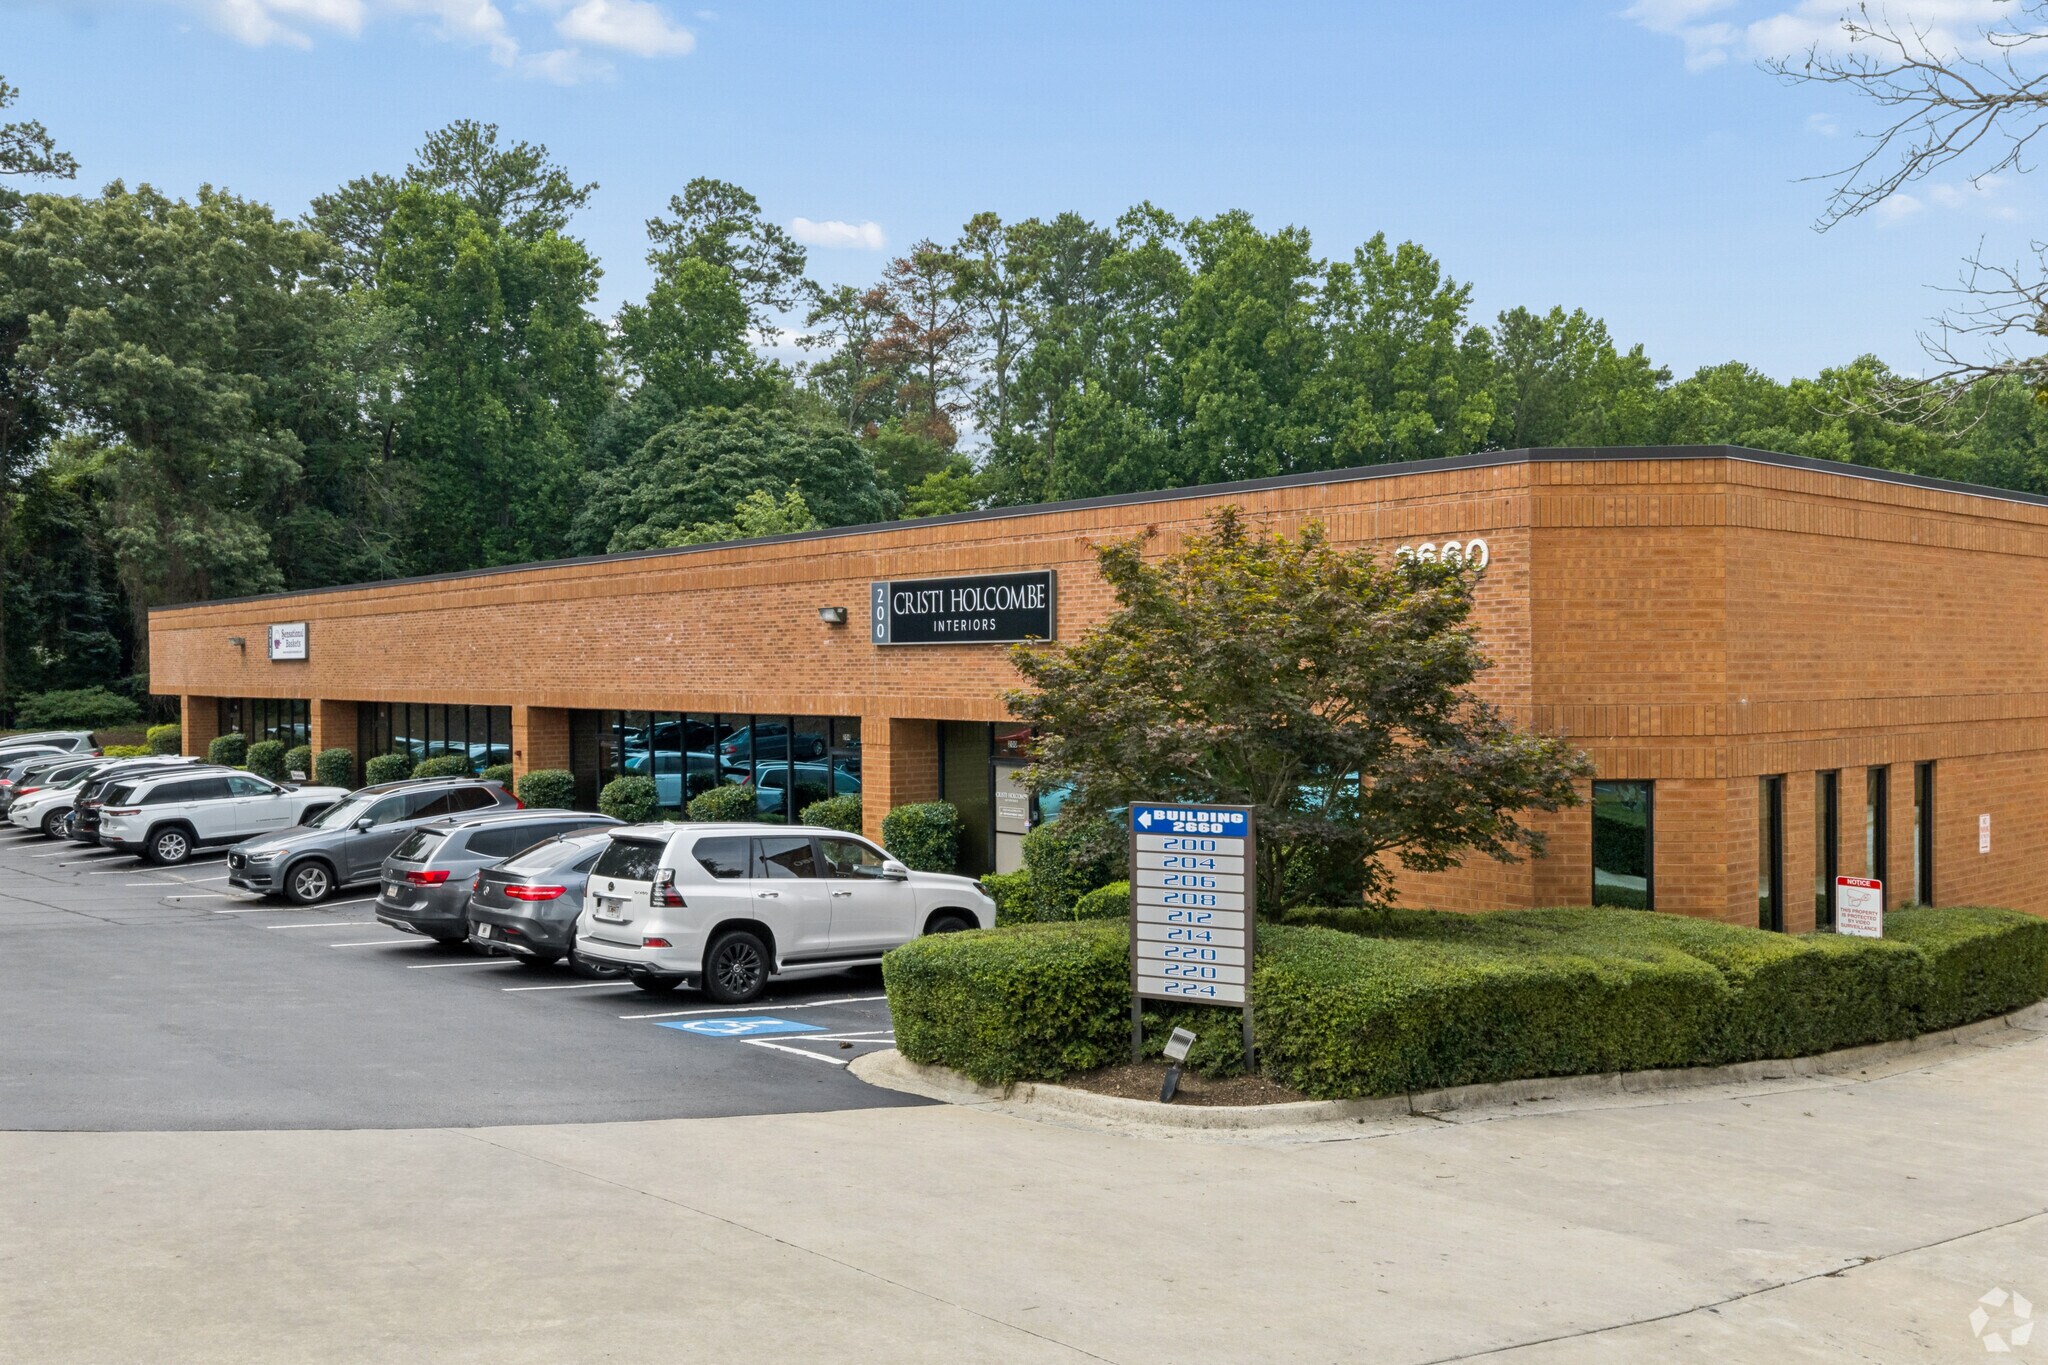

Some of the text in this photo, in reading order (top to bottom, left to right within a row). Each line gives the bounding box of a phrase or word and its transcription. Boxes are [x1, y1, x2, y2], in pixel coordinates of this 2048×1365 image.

[893, 584, 1046, 615] CRISTI HOLCOMBE
[876, 588, 885, 638] 200
[933, 618, 996, 632] INTERIORS
[1153, 809, 1243, 824] BUILDING
[1172, 821, 1223, 834] 2660
[1163, 837, 1216, 852] 200
[1163, 856, 1216, 870] 204
[1163, 874, 1216, 888] 206
[1163, 892, 1216, 906] 208
[1168, 910, 1212, 924] 212
[1841, 923, 1877, 931] SURVEILLANCE
[1168, 928, 1212, 942] 214
[1164, 945, 1217, 961] 220
[1164, 963, 1217, 979] 220
[1164, 981, 1217, 997] 224
